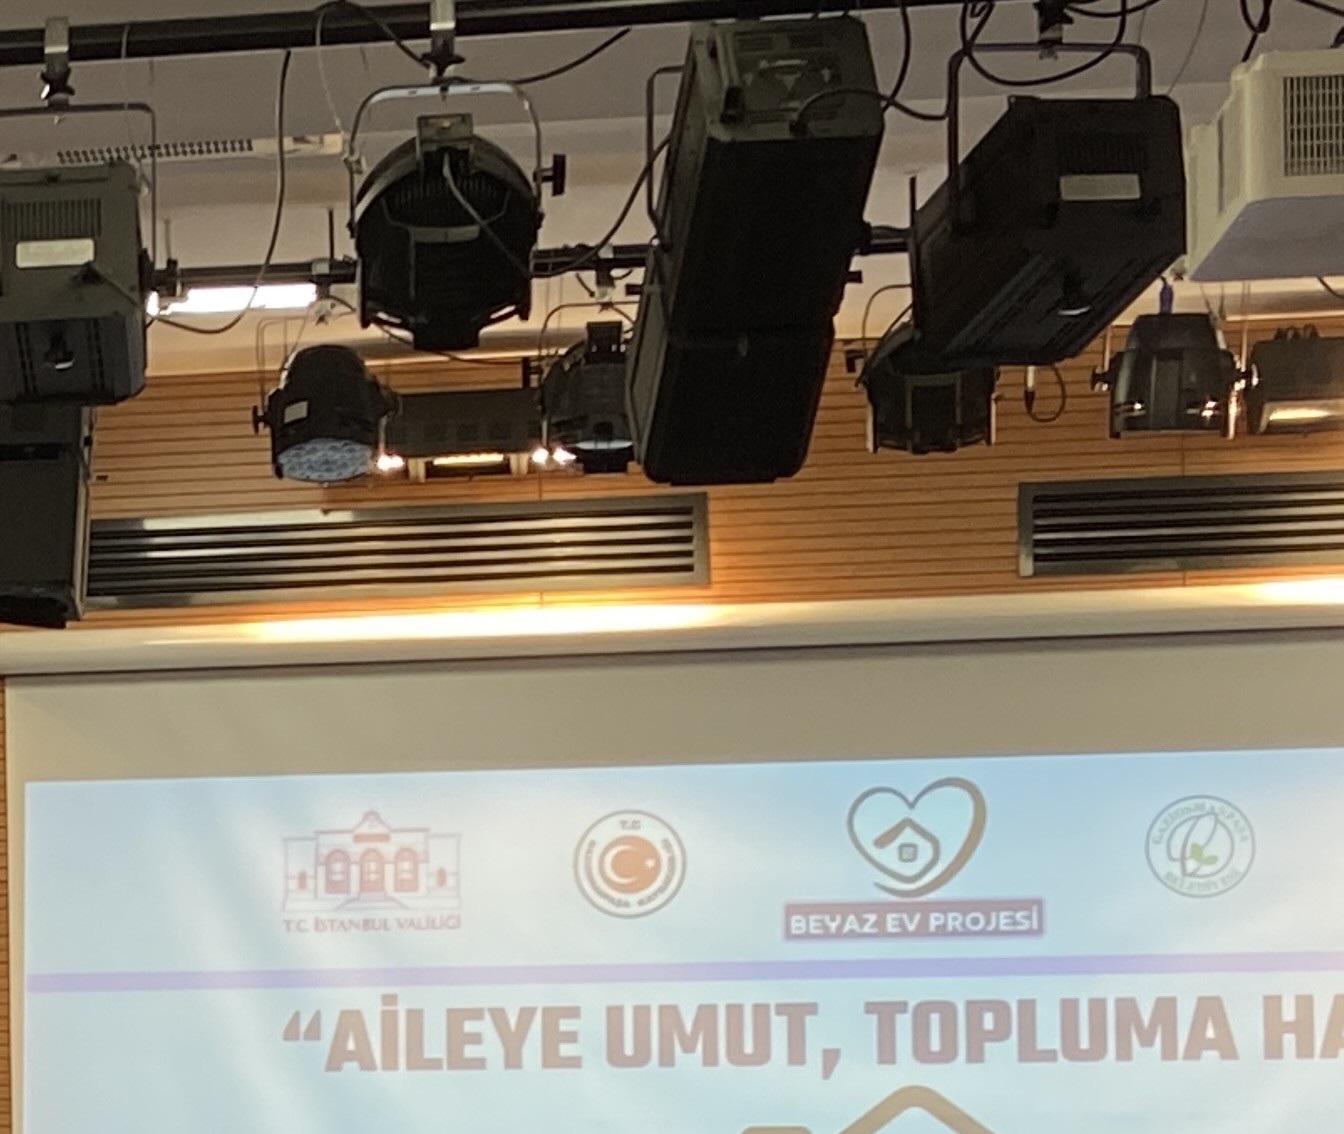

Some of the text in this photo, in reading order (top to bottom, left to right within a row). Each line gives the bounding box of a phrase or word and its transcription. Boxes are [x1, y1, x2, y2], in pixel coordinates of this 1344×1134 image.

[790, 905, 1038, 935] BEYAZ EV PROJESİ
[282, 993, 582, 1072] “AİLEYE
[605, 1002, 841, 1080] UMUT,
[864, 996, 1240, 1066] TOPLUMA
